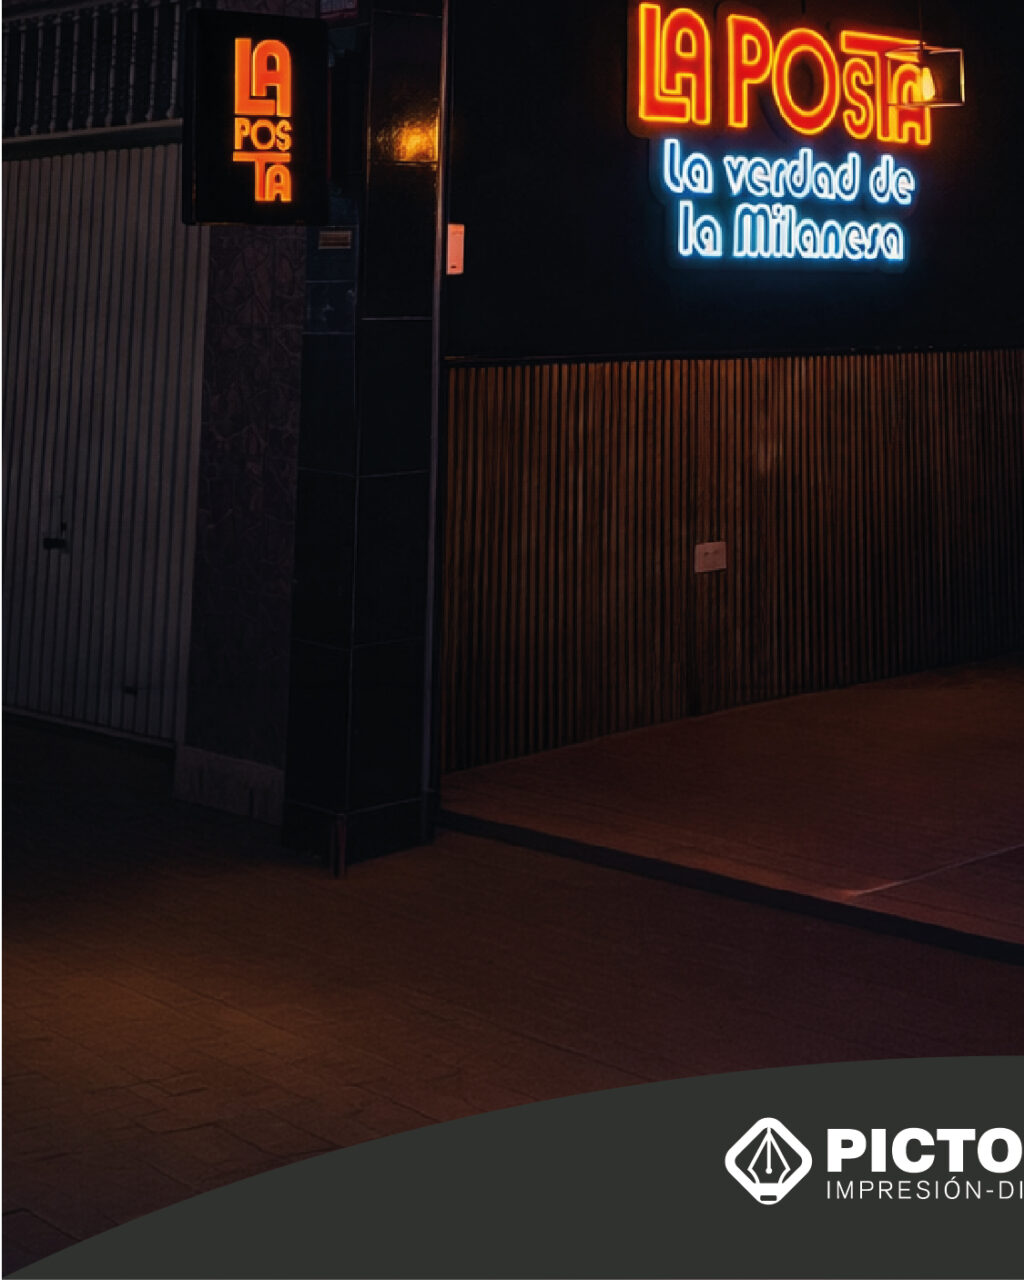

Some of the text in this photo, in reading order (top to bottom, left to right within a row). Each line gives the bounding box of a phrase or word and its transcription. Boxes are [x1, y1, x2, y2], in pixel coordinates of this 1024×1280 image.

[234, 37, 292, 118] LA
[639, 1, 932, 146] LA POSTA
[234, 117, 293, 152] POS
[232, 151, 292, 202] TA
[723, 147, 861, 201] verdad
[869, 154, 916, 205] de
[732, 202, 904, 260] Milanesa
